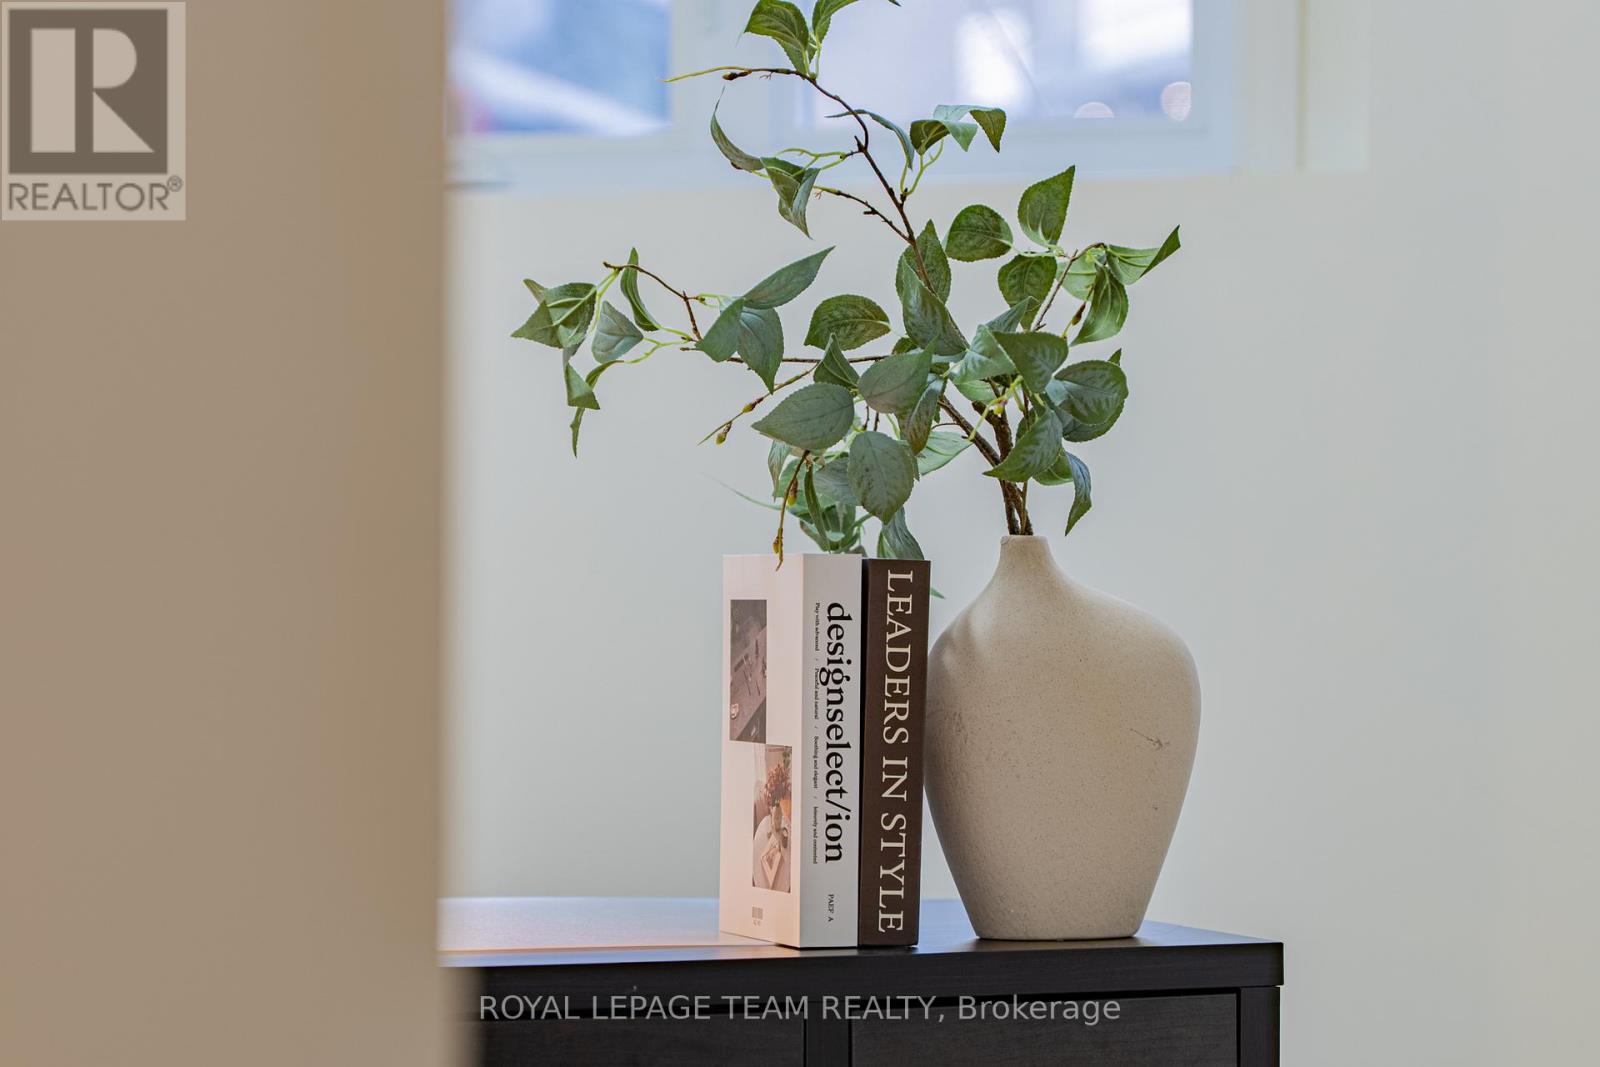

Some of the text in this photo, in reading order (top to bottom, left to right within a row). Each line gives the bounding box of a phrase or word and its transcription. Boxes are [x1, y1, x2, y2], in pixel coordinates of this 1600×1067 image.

[819, 602, 853, 864] designselect/ion
[878, 569, 913, 933] LEADERS IN STYLE
